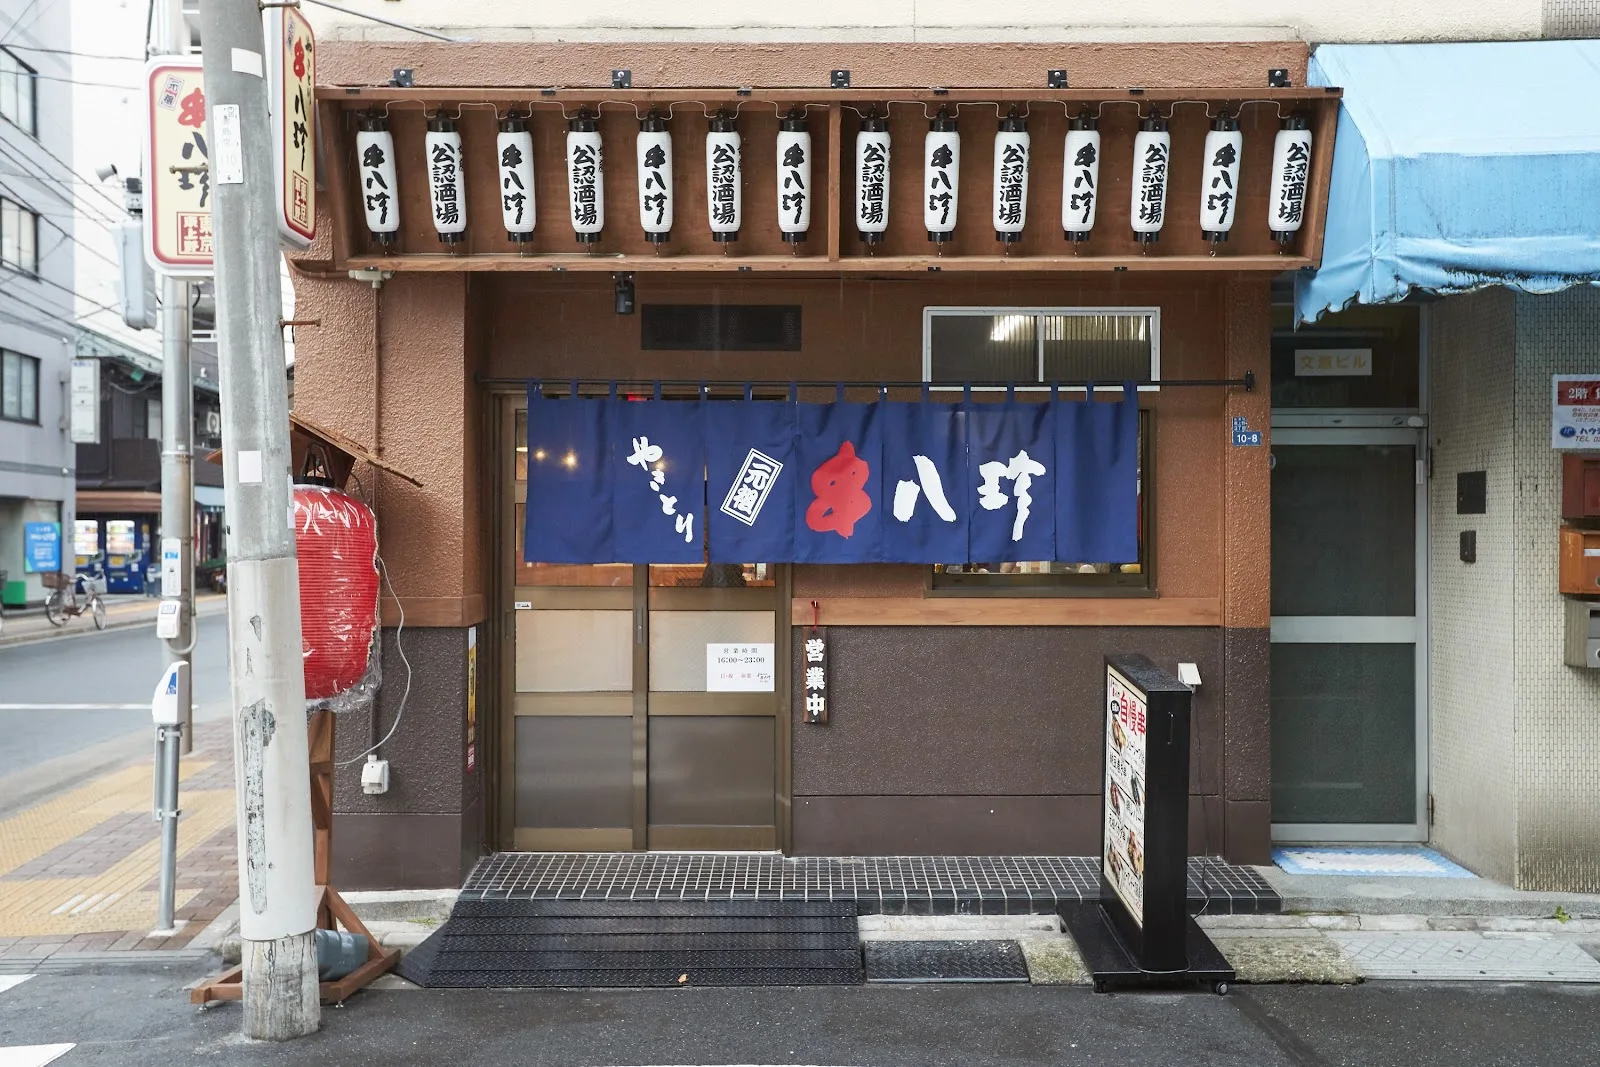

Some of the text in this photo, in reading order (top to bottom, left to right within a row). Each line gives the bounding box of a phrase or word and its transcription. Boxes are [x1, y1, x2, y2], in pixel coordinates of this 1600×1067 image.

[364, 144, 390, 224] 串八珍
[432, 143, 459, 224] 公認酒場
[502, 144, 526, 224] 串八珍
[573, 144, 597, 224] 公認酒場
[644, 144, 667, 224] 串八珍
[711, 143, 735, 224] 公認酒場
[783, 143, 805, 224] 串八珍
[861, 143, 886, 224] 公認酒場
[929, 144, 952, 224] 串八珍
[999, 143, 1025, 224] 公認酒場
[1070, 143, 1096, 224] 串八珍
[1139, 142, 1168, 224] 公認酒場
[1207, 143, 1236, 224] 串八珍
[1278, 142, 1310, 223] 公認酒場
[1568, 387, 1588, 400] 2階
[1236, 434, 1258, 443] 10-8
[626, 436, 693, 543] やきとり
[733, 462, 772, 515] 元祖
[805, 440, 1046, 541] 串八珍
[805, 638, 825, 716] 営業中
[1120, 690, 1147, 741] 自慢串
